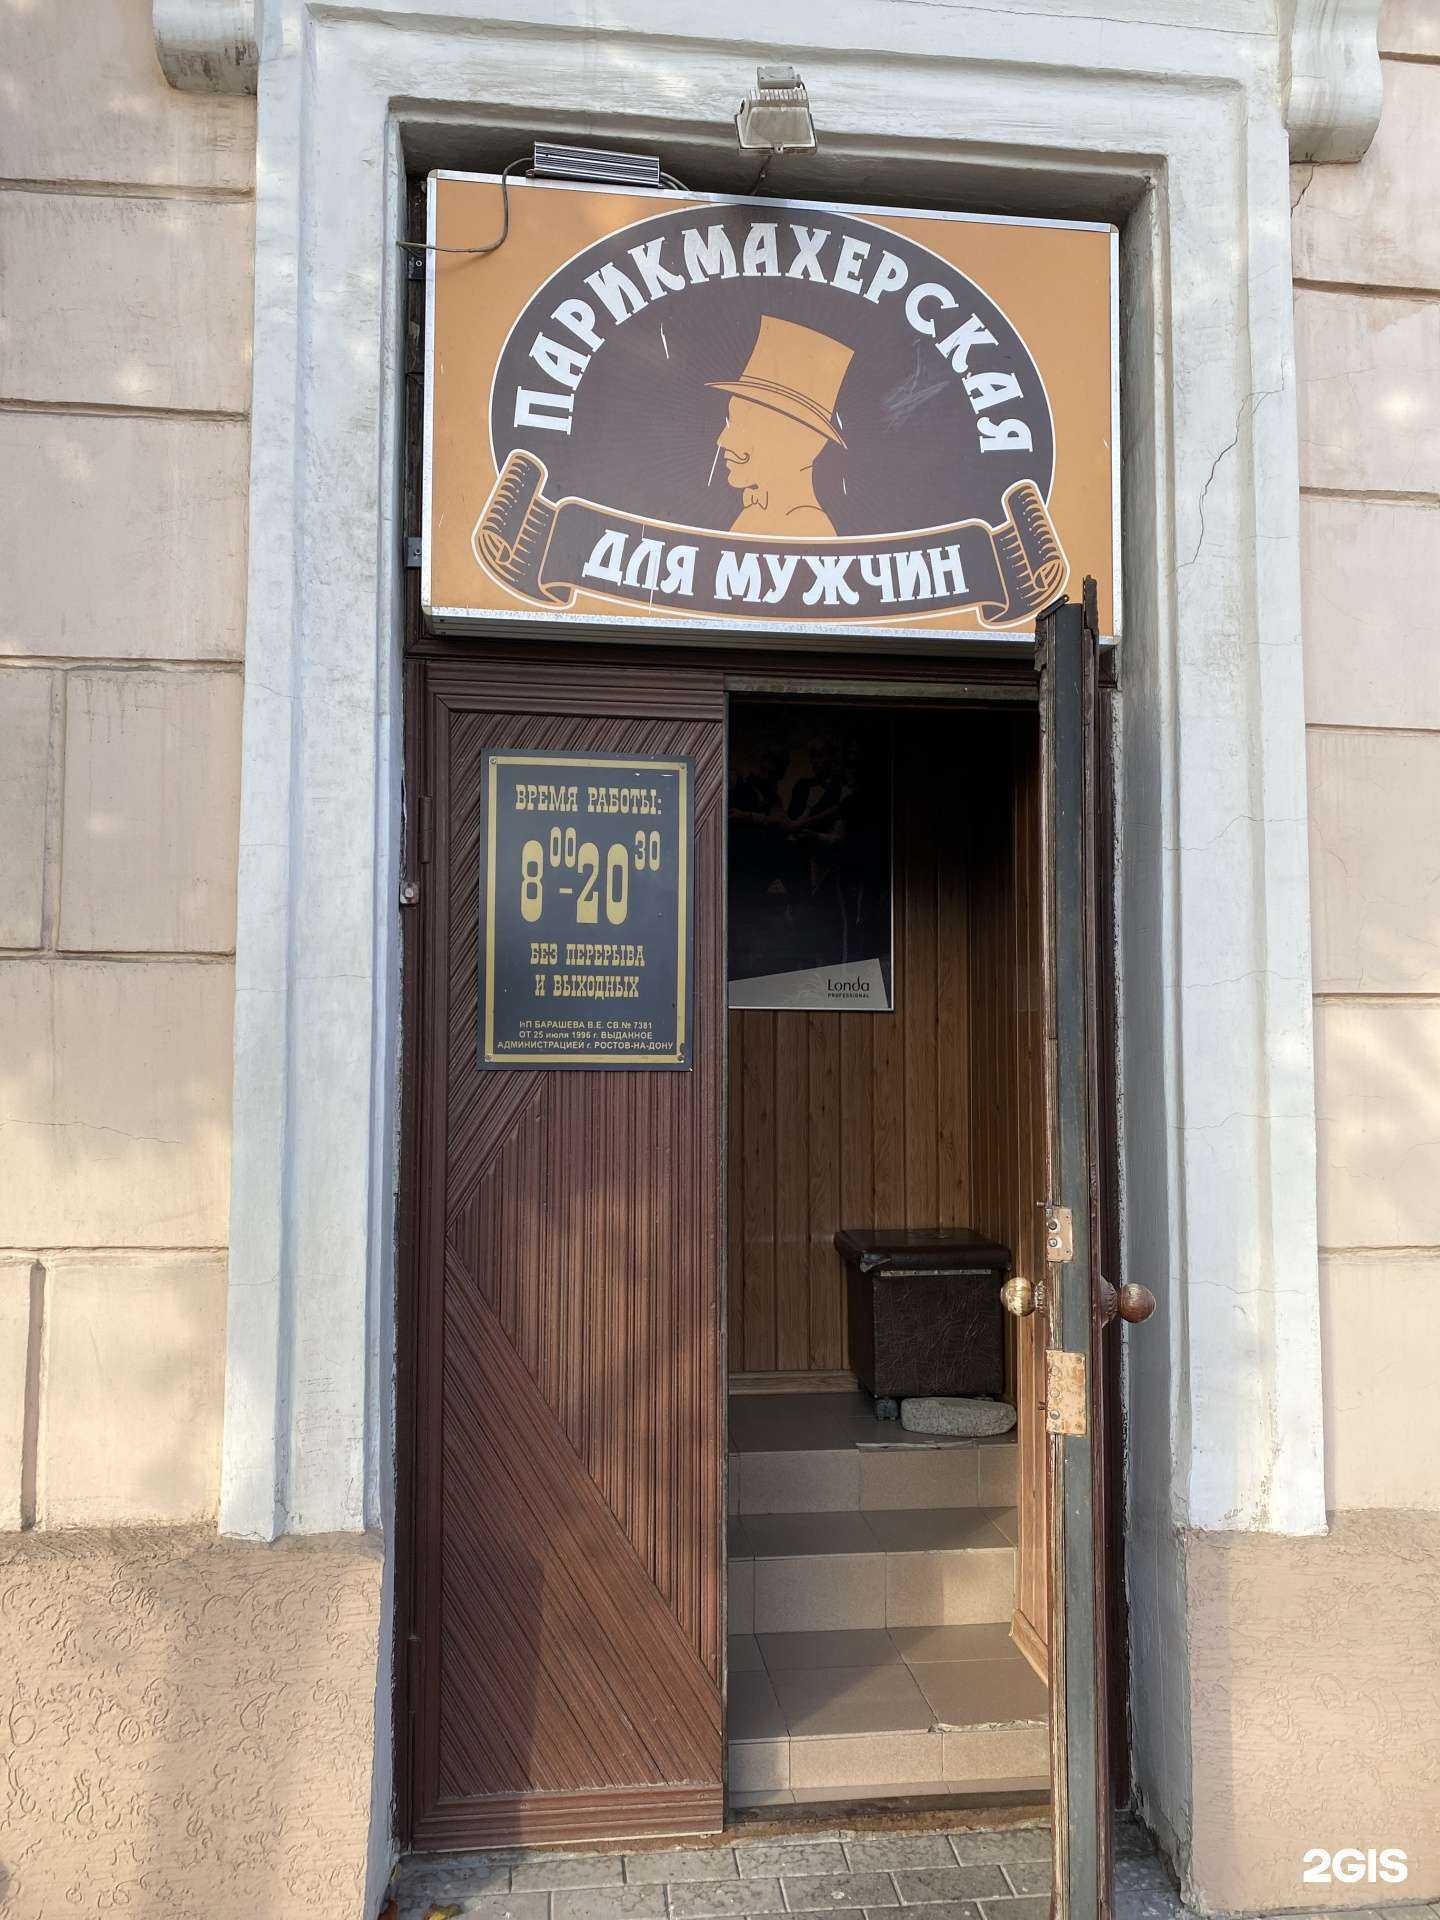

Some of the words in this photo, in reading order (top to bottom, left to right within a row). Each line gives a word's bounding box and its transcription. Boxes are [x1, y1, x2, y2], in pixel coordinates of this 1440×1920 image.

[513, 222, 1033, 454] ПАРИКМАХЕРСКАЯ
[582, 529, 699, 596] ДЛЯ
[713, 544, 970, 605] МУЖЧИН
[515, 784, 578, 813] ВРЕМЯ
[587, 787, 662, 815] РАБОТЫ:
[530, 943, 558, 965] БЕЗ
[566, 944, 646, 967] ПЕРЕРЫВА
[535, 975, 546, 996] И
[553, 976, 640, 1000] ВЫХОДНЫХ
[827, 976, 870, 992] Londa
[519, 1031, 531, 1039] ОТ
[600, 1032, 653, 1041] ВЫДАННОЕ
[534, 1021, 585, 1029] БАРАШЕВА
[497, 1040, 585, 1050] АДМИНИСТРАЦИЕЙ
[594, 1041, 673, 1051] РОСТОВ-НА-ДОНУ
